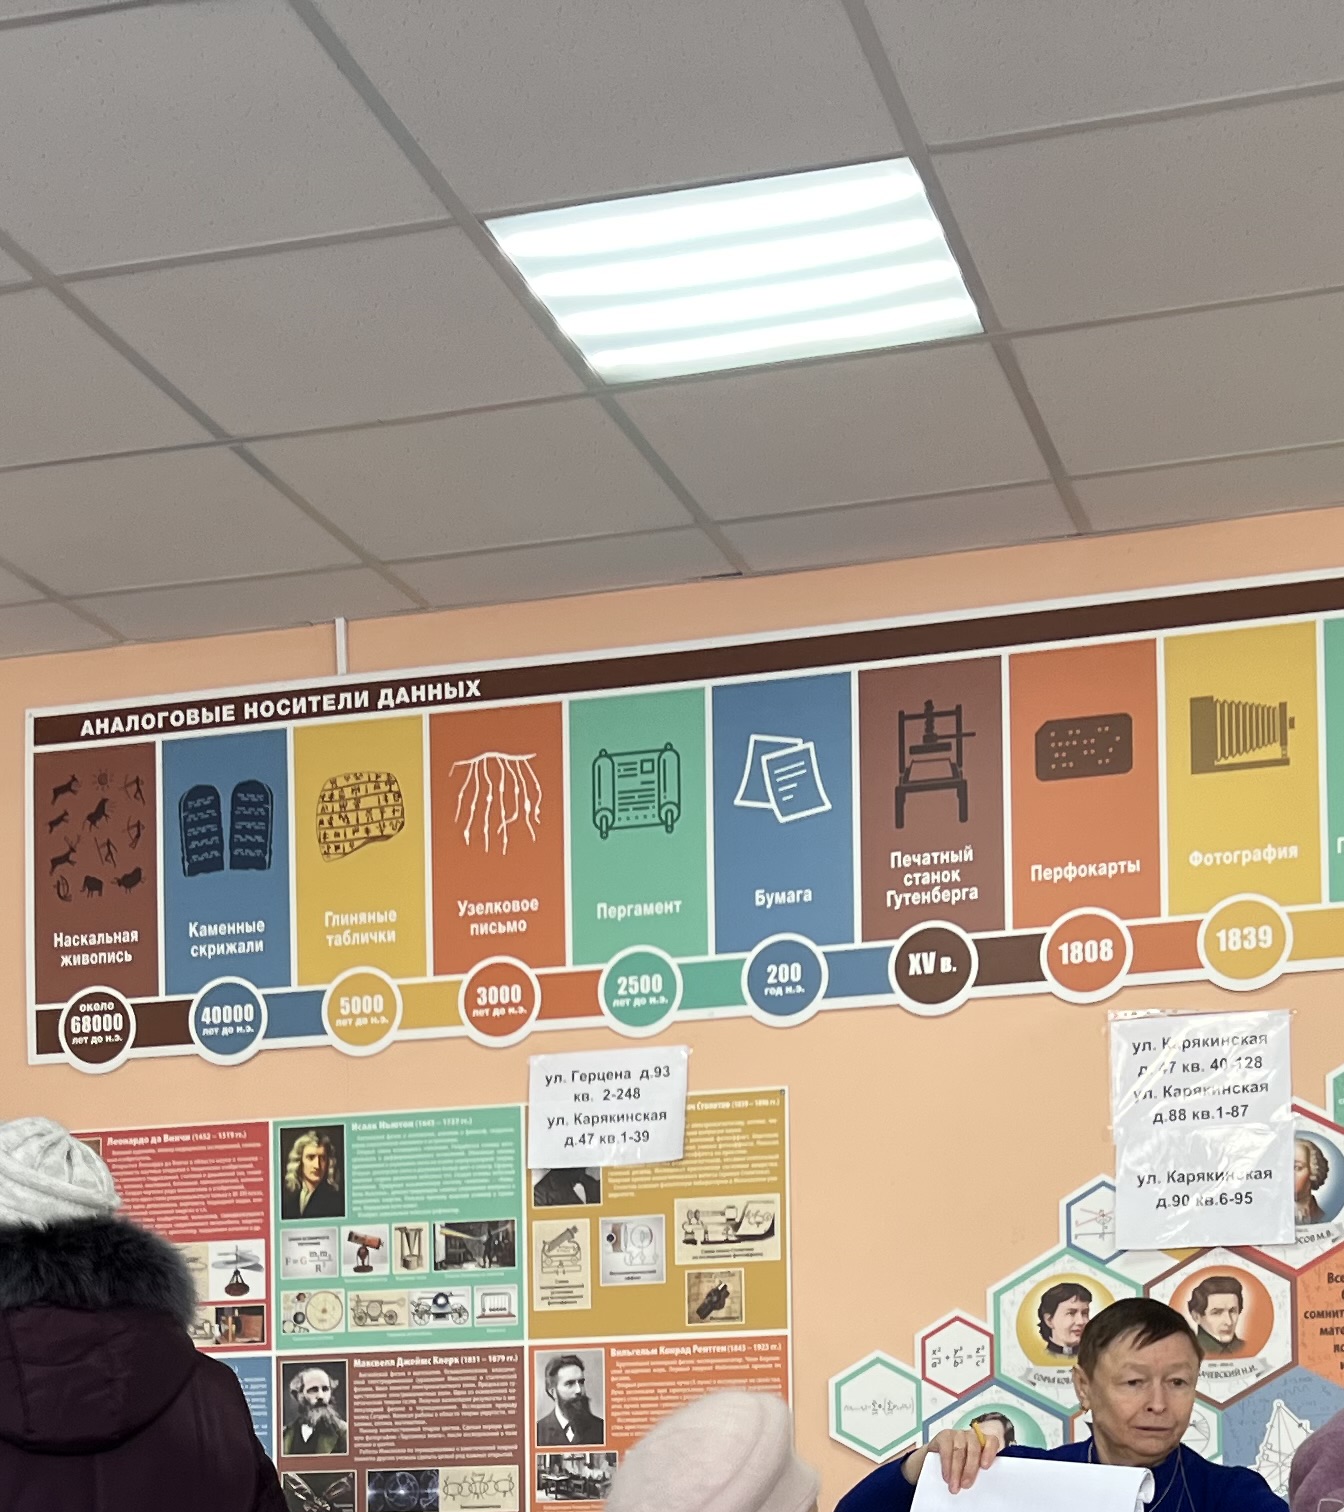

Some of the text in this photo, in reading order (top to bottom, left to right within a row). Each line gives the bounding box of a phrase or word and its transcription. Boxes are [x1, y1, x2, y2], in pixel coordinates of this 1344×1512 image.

[80, 678, 482, 738] АНАЛОГОВЫЕ НОСИТЕЛИ ДАННЫХ
[890, 845, 974, 869] Печатный
[1188, 842, 1299, 869] Фотография
[903, 868, 961, 886] станок
[1030, 858, 1141, 884] Перфокарты
[457, 896, 540, 916] Узелковое
[754, 886, 813, 909] Бумага
[886, 884, 979, 909] Гутенберга
[324, 907, 397, 927] Глиняные
[596, 898, 682, 921] Пергамент
[188, 918, 266, 938] Каменные
[326, 927, 397, 947] таблички
[470, 917, 528, 936] письмо
[53, 928, 139, 948] Наскальная
[190, 938, 265, 959] скрижали
[1216, 925, 1274, 951] 1839
[60, 948, 133, 967] живопись
[1058, 938, 1115, 965] 1808
[766, 962, 803, 985] 200
[907, 951, 957, 977] XV в.
[476, 983, 522, 1006] 3000
[617, 973, 663, 996] 2500
[201, 1003, 254, 1026] 40000
[339, 994, 384, 1016] 5000
[70, 1012, 124, 1035] 68000
[1131, 1034, 1268, 1056] ул. Крякинская
[545, 1065, 671, 1087] ул. Герцена д.93
[1182, 1062, 1204, 1073] кв.
[574, 1087, 641, 1103] кв. 2-248
[1133, 1081, 1269, 1104] ул. Карякинская
[547, 1109, 668, 1128] ул. Карякинская
[1153, 1109, 1187, 1124] д.88
[107, 1135, 149, 1146] Леонардо
[163, 1133, 191, 1143] Винчи
[564, 1133, 594, 1148] д.47
[1137, 1173, 1162, 1188] ул.
[1156, 1194, 1190, 1210] д.90
